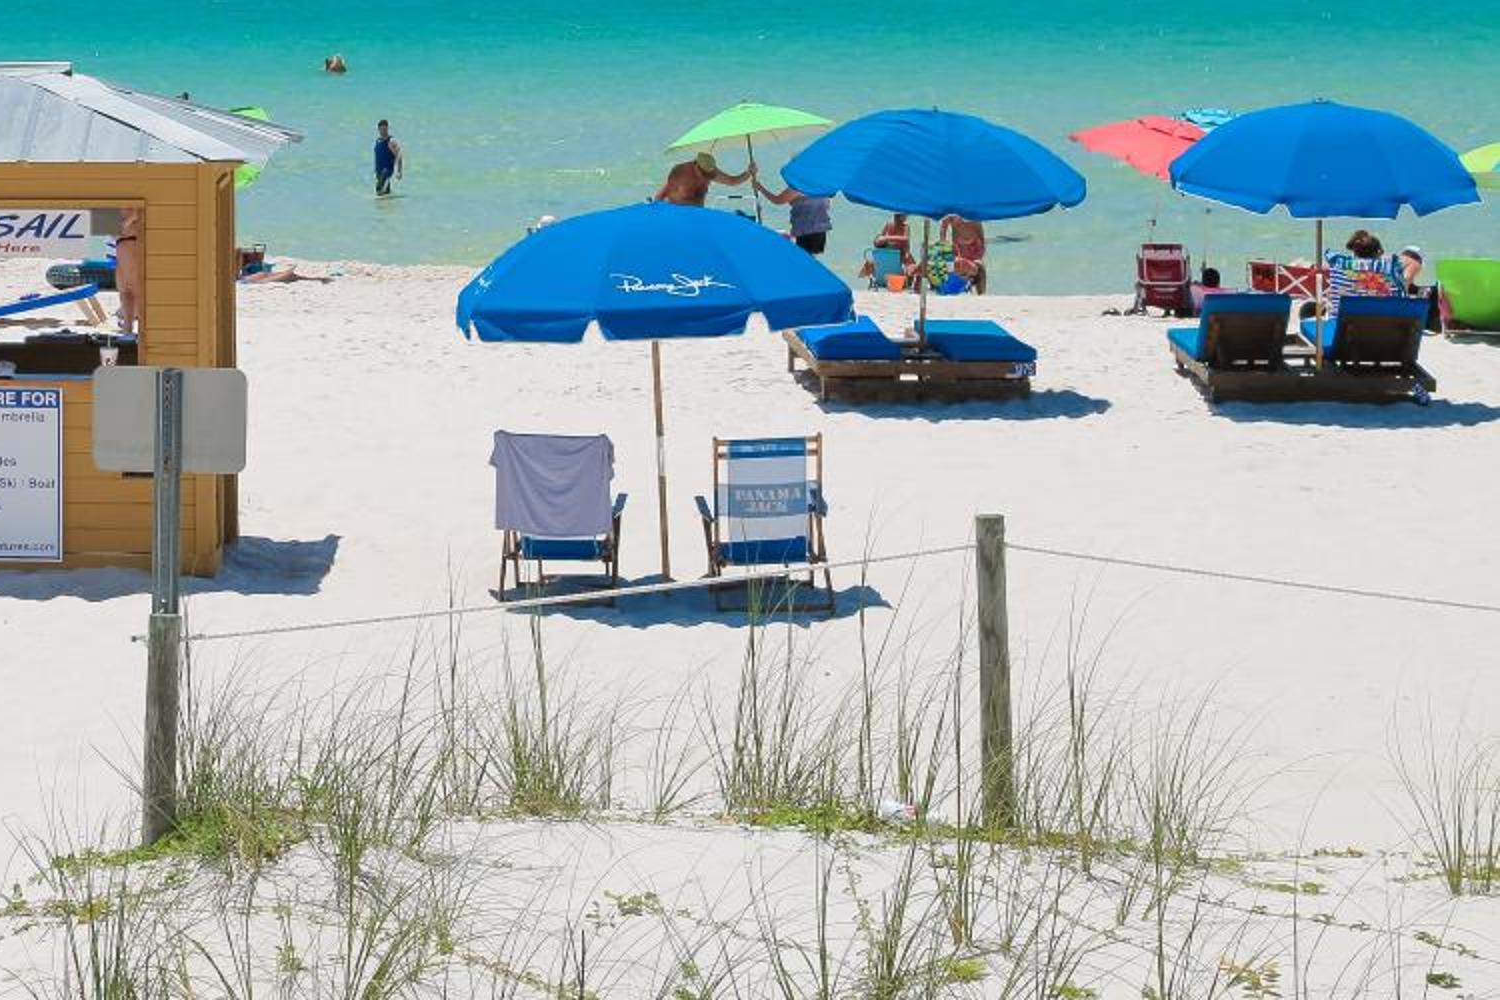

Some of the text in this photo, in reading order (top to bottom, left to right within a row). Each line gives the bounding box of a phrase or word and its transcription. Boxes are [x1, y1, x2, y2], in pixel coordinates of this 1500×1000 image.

[21, 392, 57, 406] FOR
[29, 478, 56, 489] Boat
[734, 488, 801, 501] PANAMA
